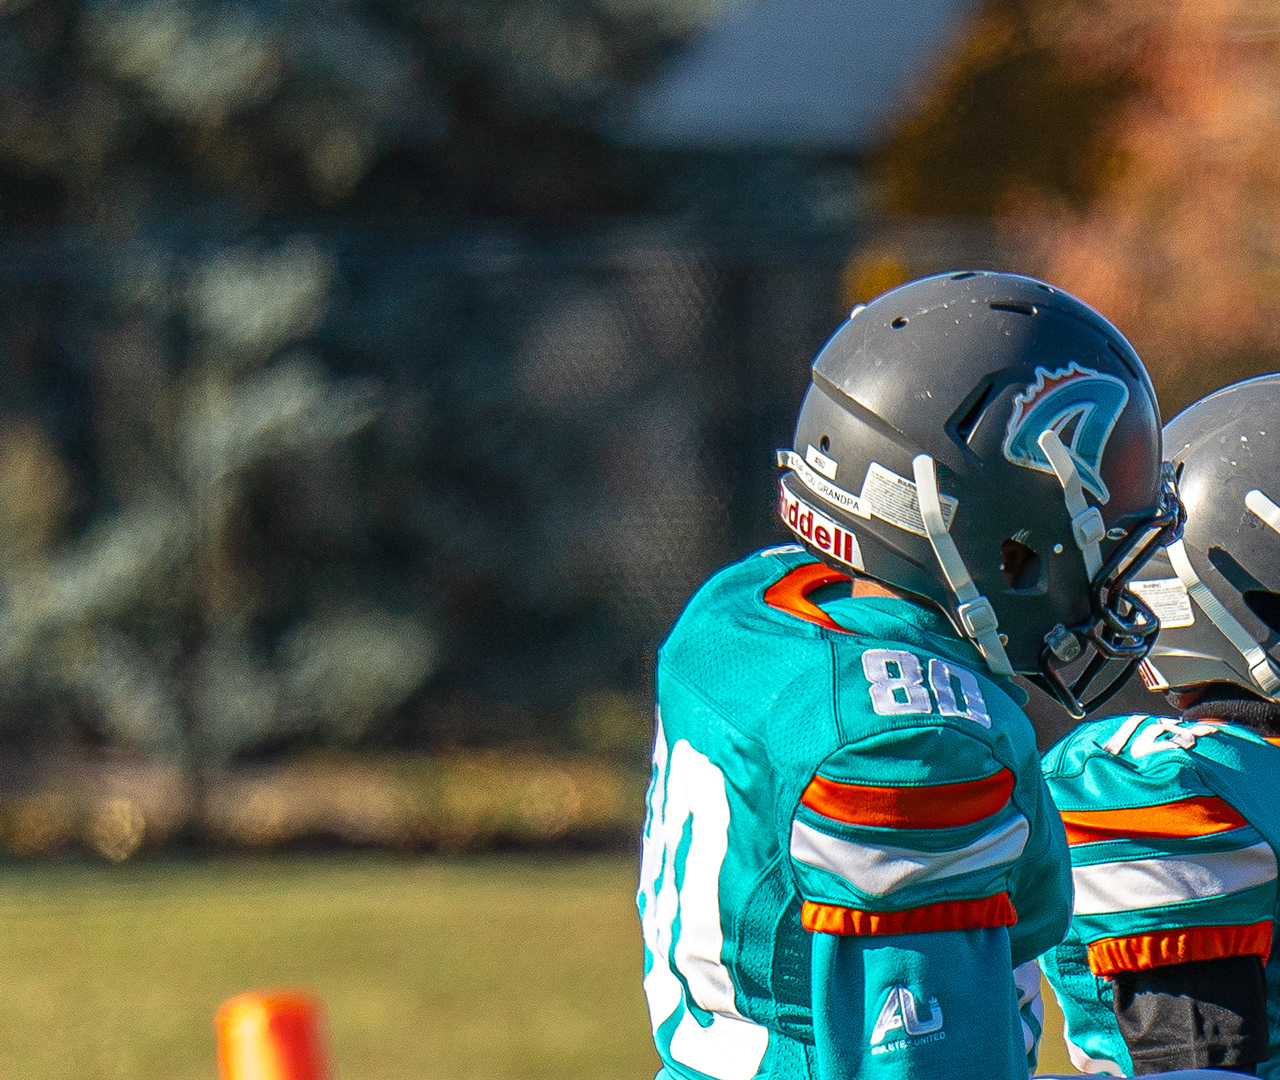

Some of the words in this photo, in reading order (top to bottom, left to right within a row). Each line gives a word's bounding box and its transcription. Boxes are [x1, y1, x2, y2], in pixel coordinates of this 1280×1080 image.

[818, 481, 860, 511] GRANDPA
[779, 488, 853, 564] iddell
[862, 649, 991, 729] 80
[914, 1031, 946, 1046] UNITED
